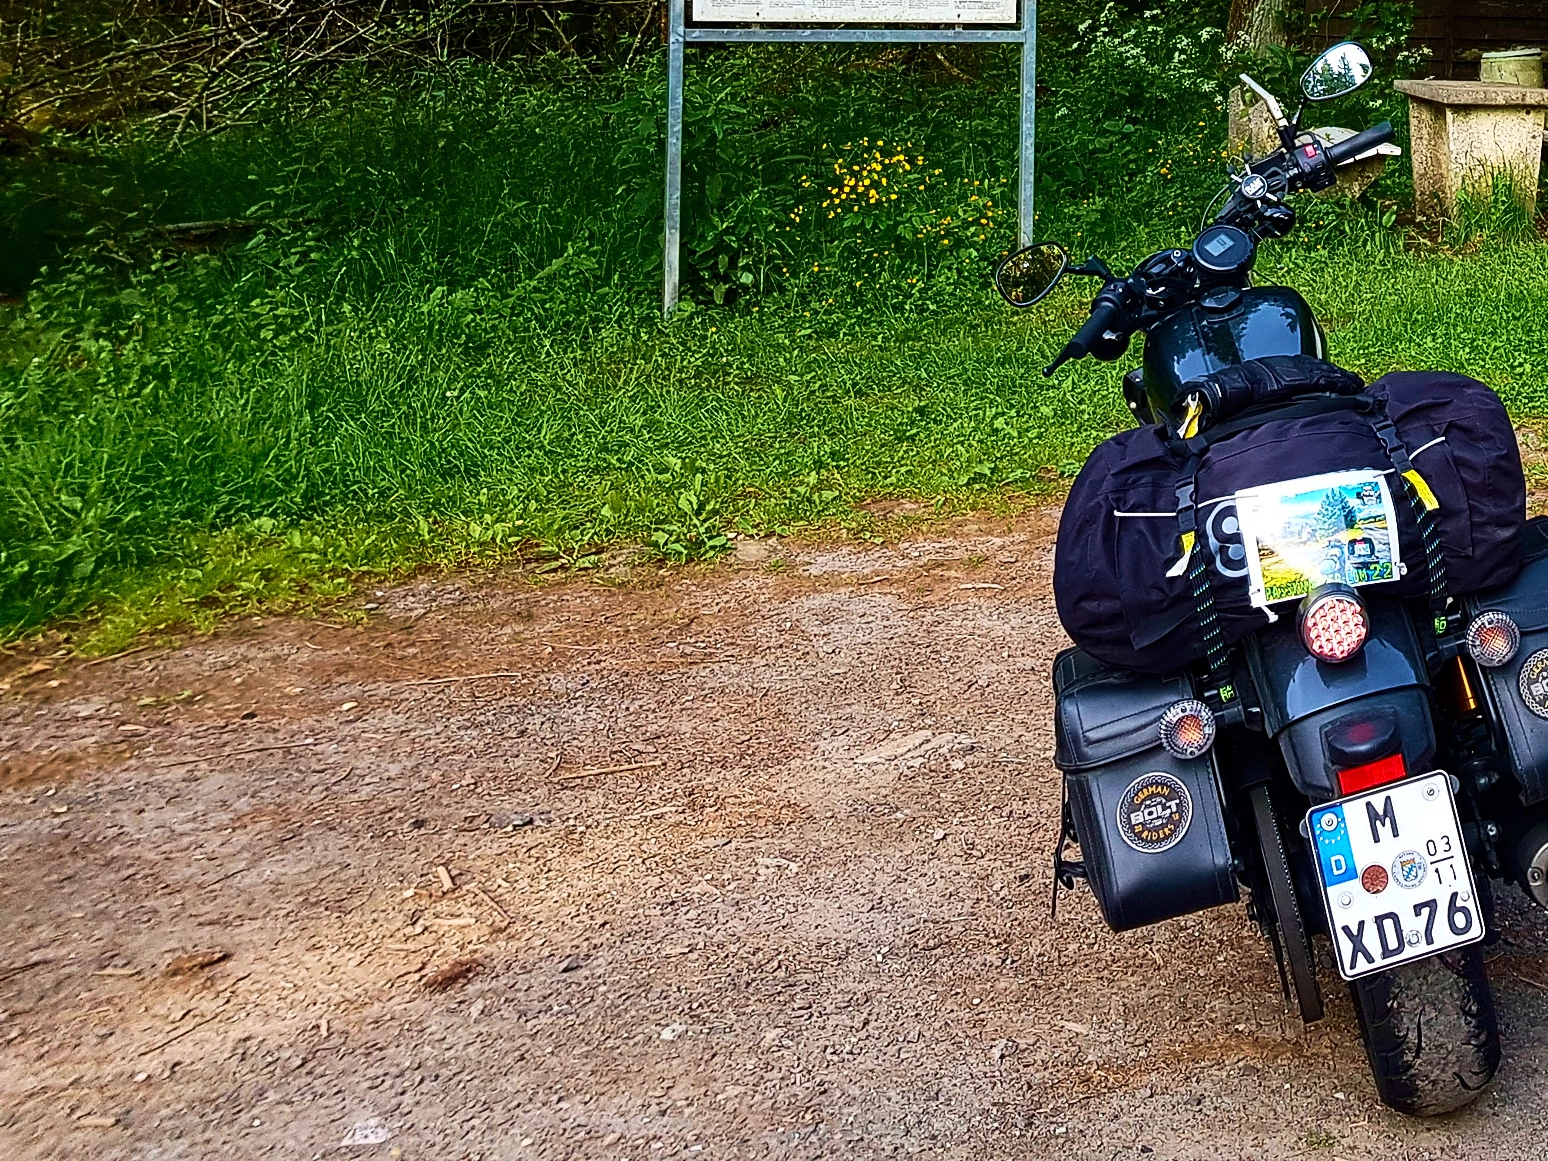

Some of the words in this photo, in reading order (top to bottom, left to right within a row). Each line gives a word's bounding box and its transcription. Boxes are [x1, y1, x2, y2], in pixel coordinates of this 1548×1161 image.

[1370, 562, 1393, 580] 22
[1133, 785, 1170, 804] GERMAN
[1130, 799, 1180, 825] BOLT
[1365, 795, 1400, 843] M
[1141, 824, 1175, 840] RIDERS
[1426, 835, 1452, 857] 03
[1330, 854, 1347, 876] D
[1434, 863, 1457, 885] 11
